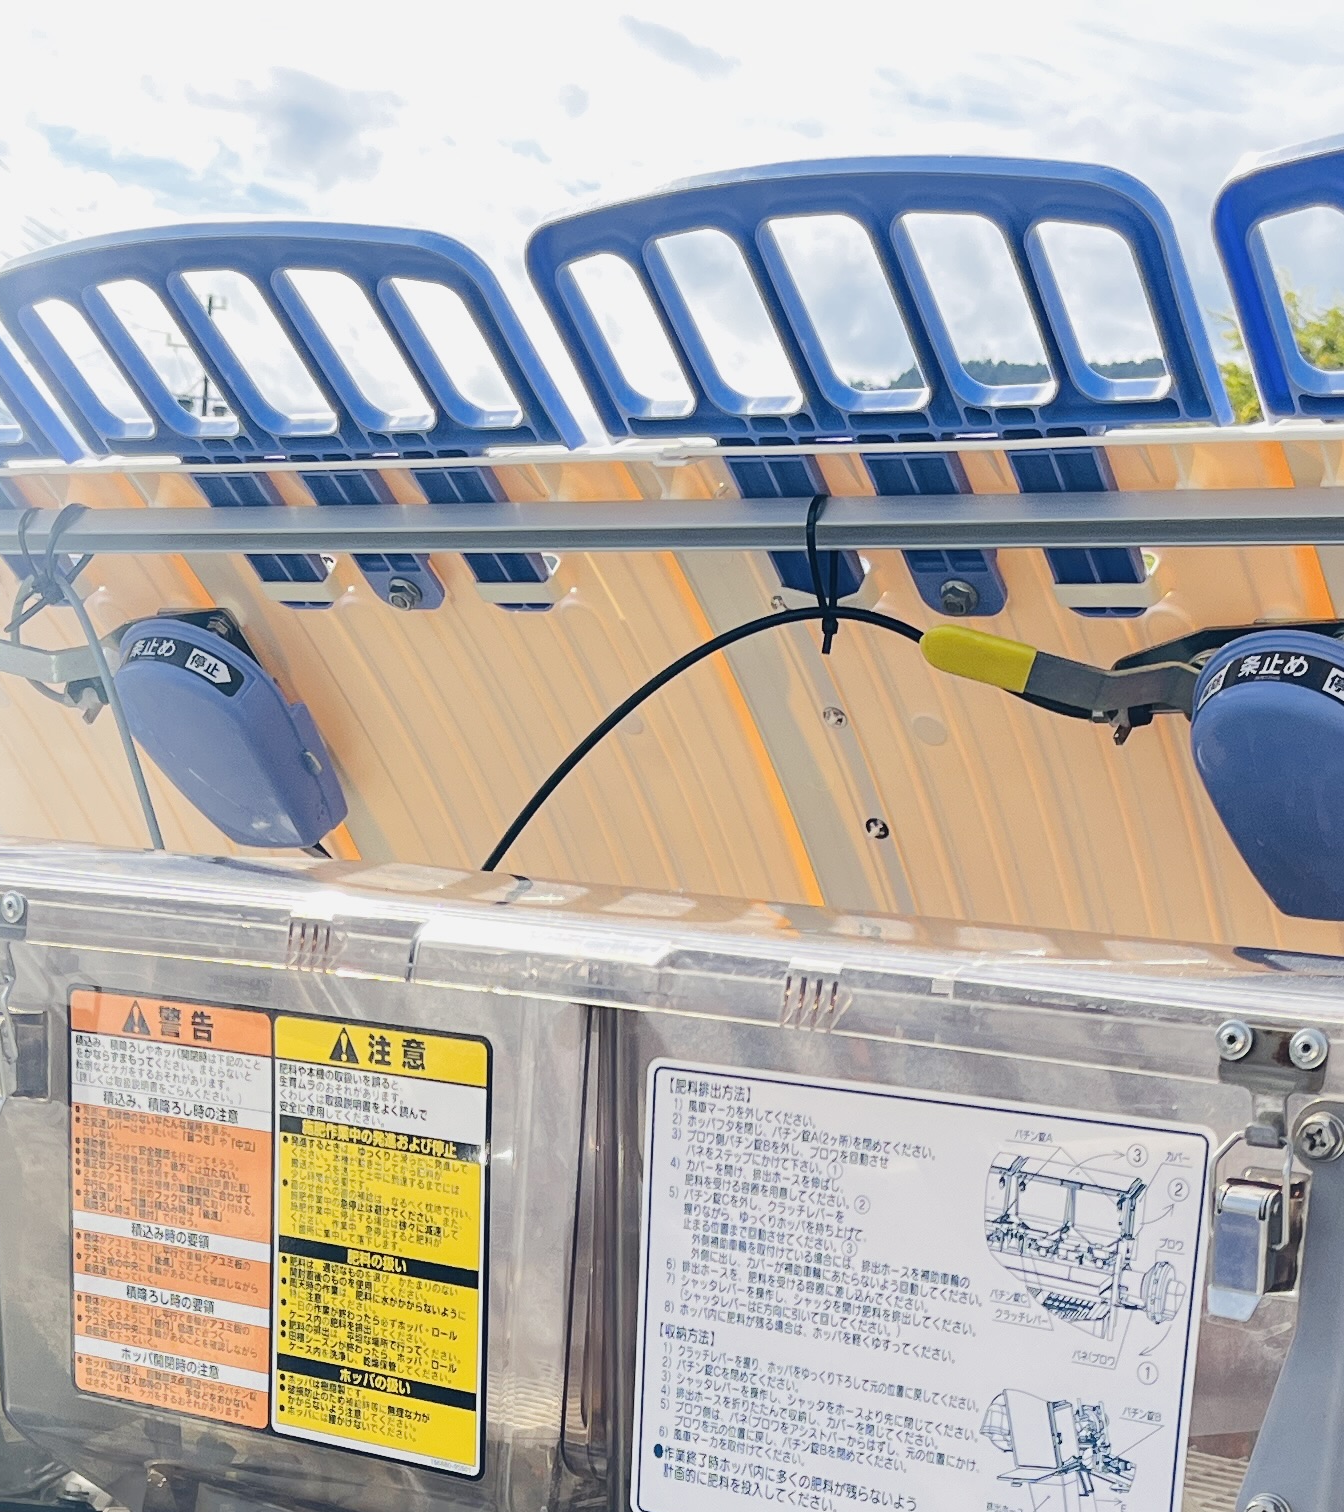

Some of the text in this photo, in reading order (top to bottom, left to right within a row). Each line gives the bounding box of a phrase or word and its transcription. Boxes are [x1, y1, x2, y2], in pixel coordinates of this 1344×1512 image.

[130, 637, 177, 658] 条止め
[190, 652, 221, 679] 停止
[1238, 653, 1309, 677] 条止め
[159, 1005, 213, 1042] 警告
[368, 1033, 425, 1071] 注意
[667, 1076, 754, 1103] 【肥料排出方法】
[103, 1090, 238, 1124] 積込み、積降ろし時の注意
[673, 1097, 683, 1110] 1)
[279, 1101, 385, 1127] 安全に使用してください。
[672, 1112, 682, 1124] 2)
[671, 1127, 681, 1139] 3)
[670, 1156, 680, 1168] 4)
[668, 1186, 679, 1198] 5)
[131, 1222, 209, 1250] 積込み時の要領
[1158, 1237, 1184, 1251] ブロワ
[347, 1248, 407, 1274] 肥料の扱い
[665, 1257, 676, 1270] 6)
[665, 1272, 675, 1284] 7)
[126, 1284, 214, 1315] 積降ろし時の要領
[664, 1300, 674, 1313] 8)
[993, 1308, 1049, 1327] クラッチレバー
[658, 1321, 717, 1347] 【収納方法】
[663, 1342, 672, 1354] 1)
[121, 1346, 219, 1380] ホッパ開閉時の注意
[661, 1356, 672, 1368] 2)
[339, 1367, 411, 1396] ホッパの扱い
[661, 1370, 671, 1382] 3)
[660, 1384, 670, 1396] 4)
[658, 1426, 669, 1438] 6)
